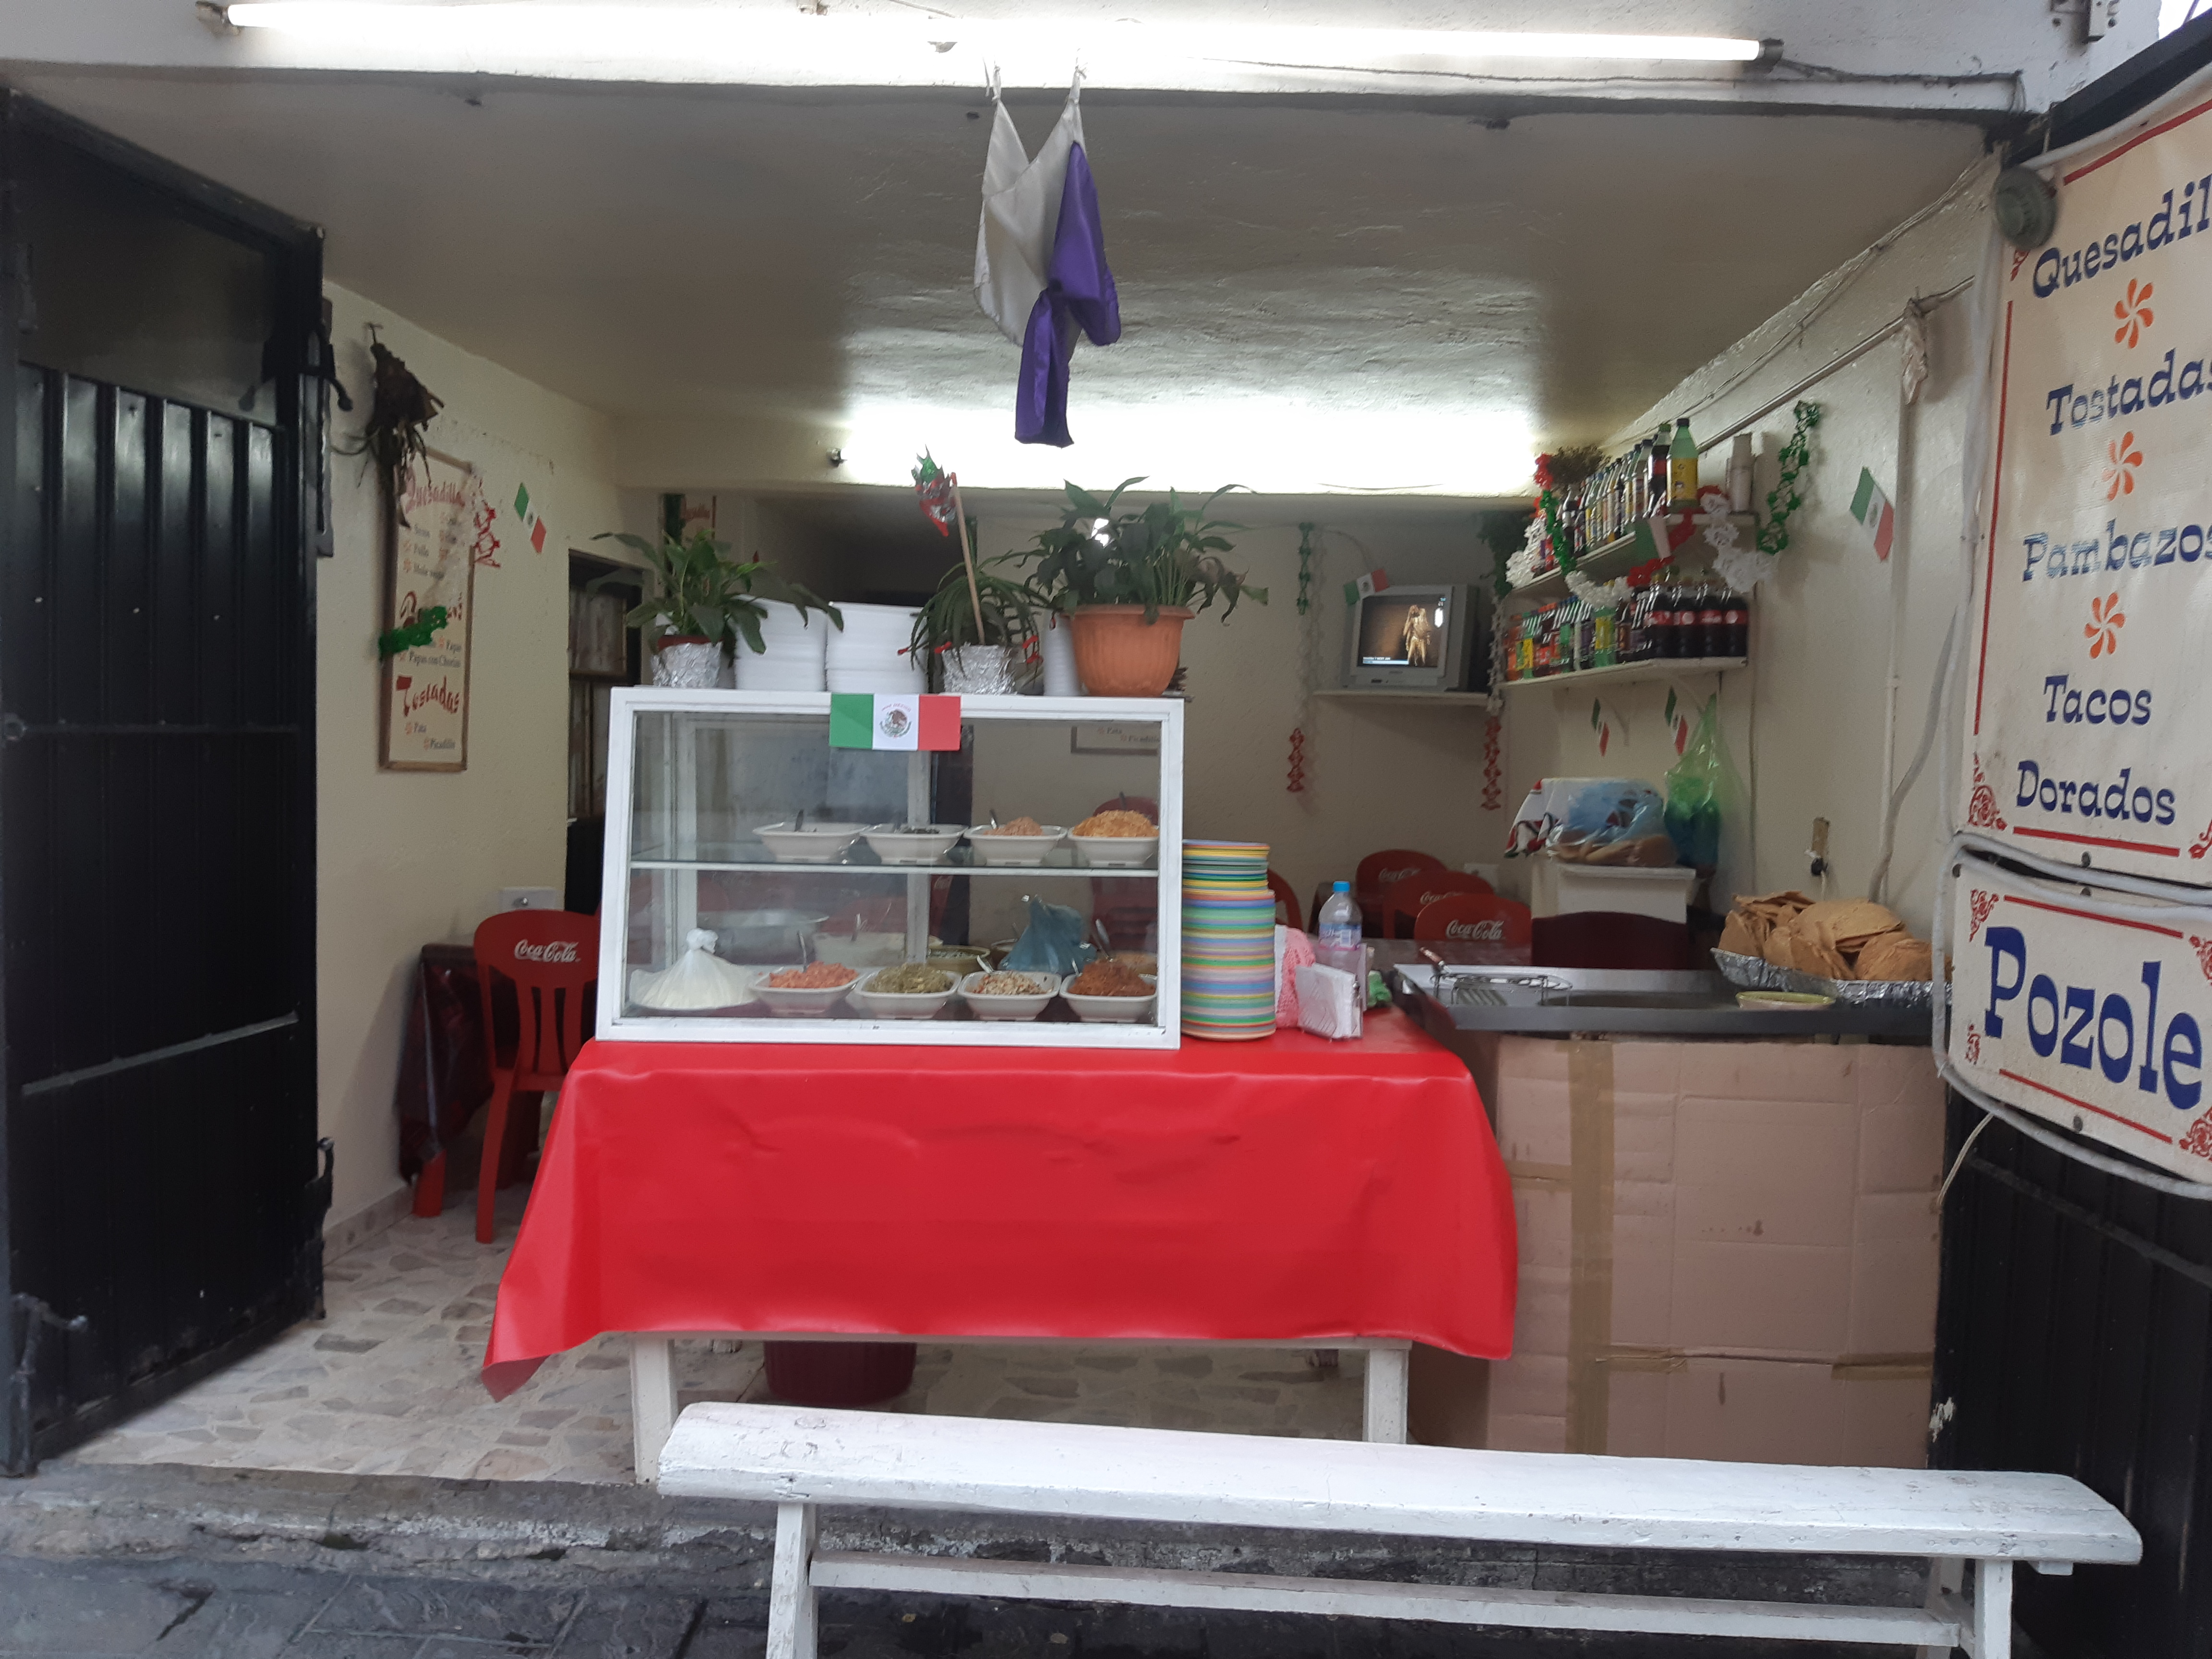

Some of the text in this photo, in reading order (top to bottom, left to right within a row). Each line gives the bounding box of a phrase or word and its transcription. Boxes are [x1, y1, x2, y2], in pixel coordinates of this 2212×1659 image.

[2044, 674, 2152, 725] Tacos
[2017, 760, 2176, 825] Dorados
[1984, 926, 2202, 1110] Pozole
